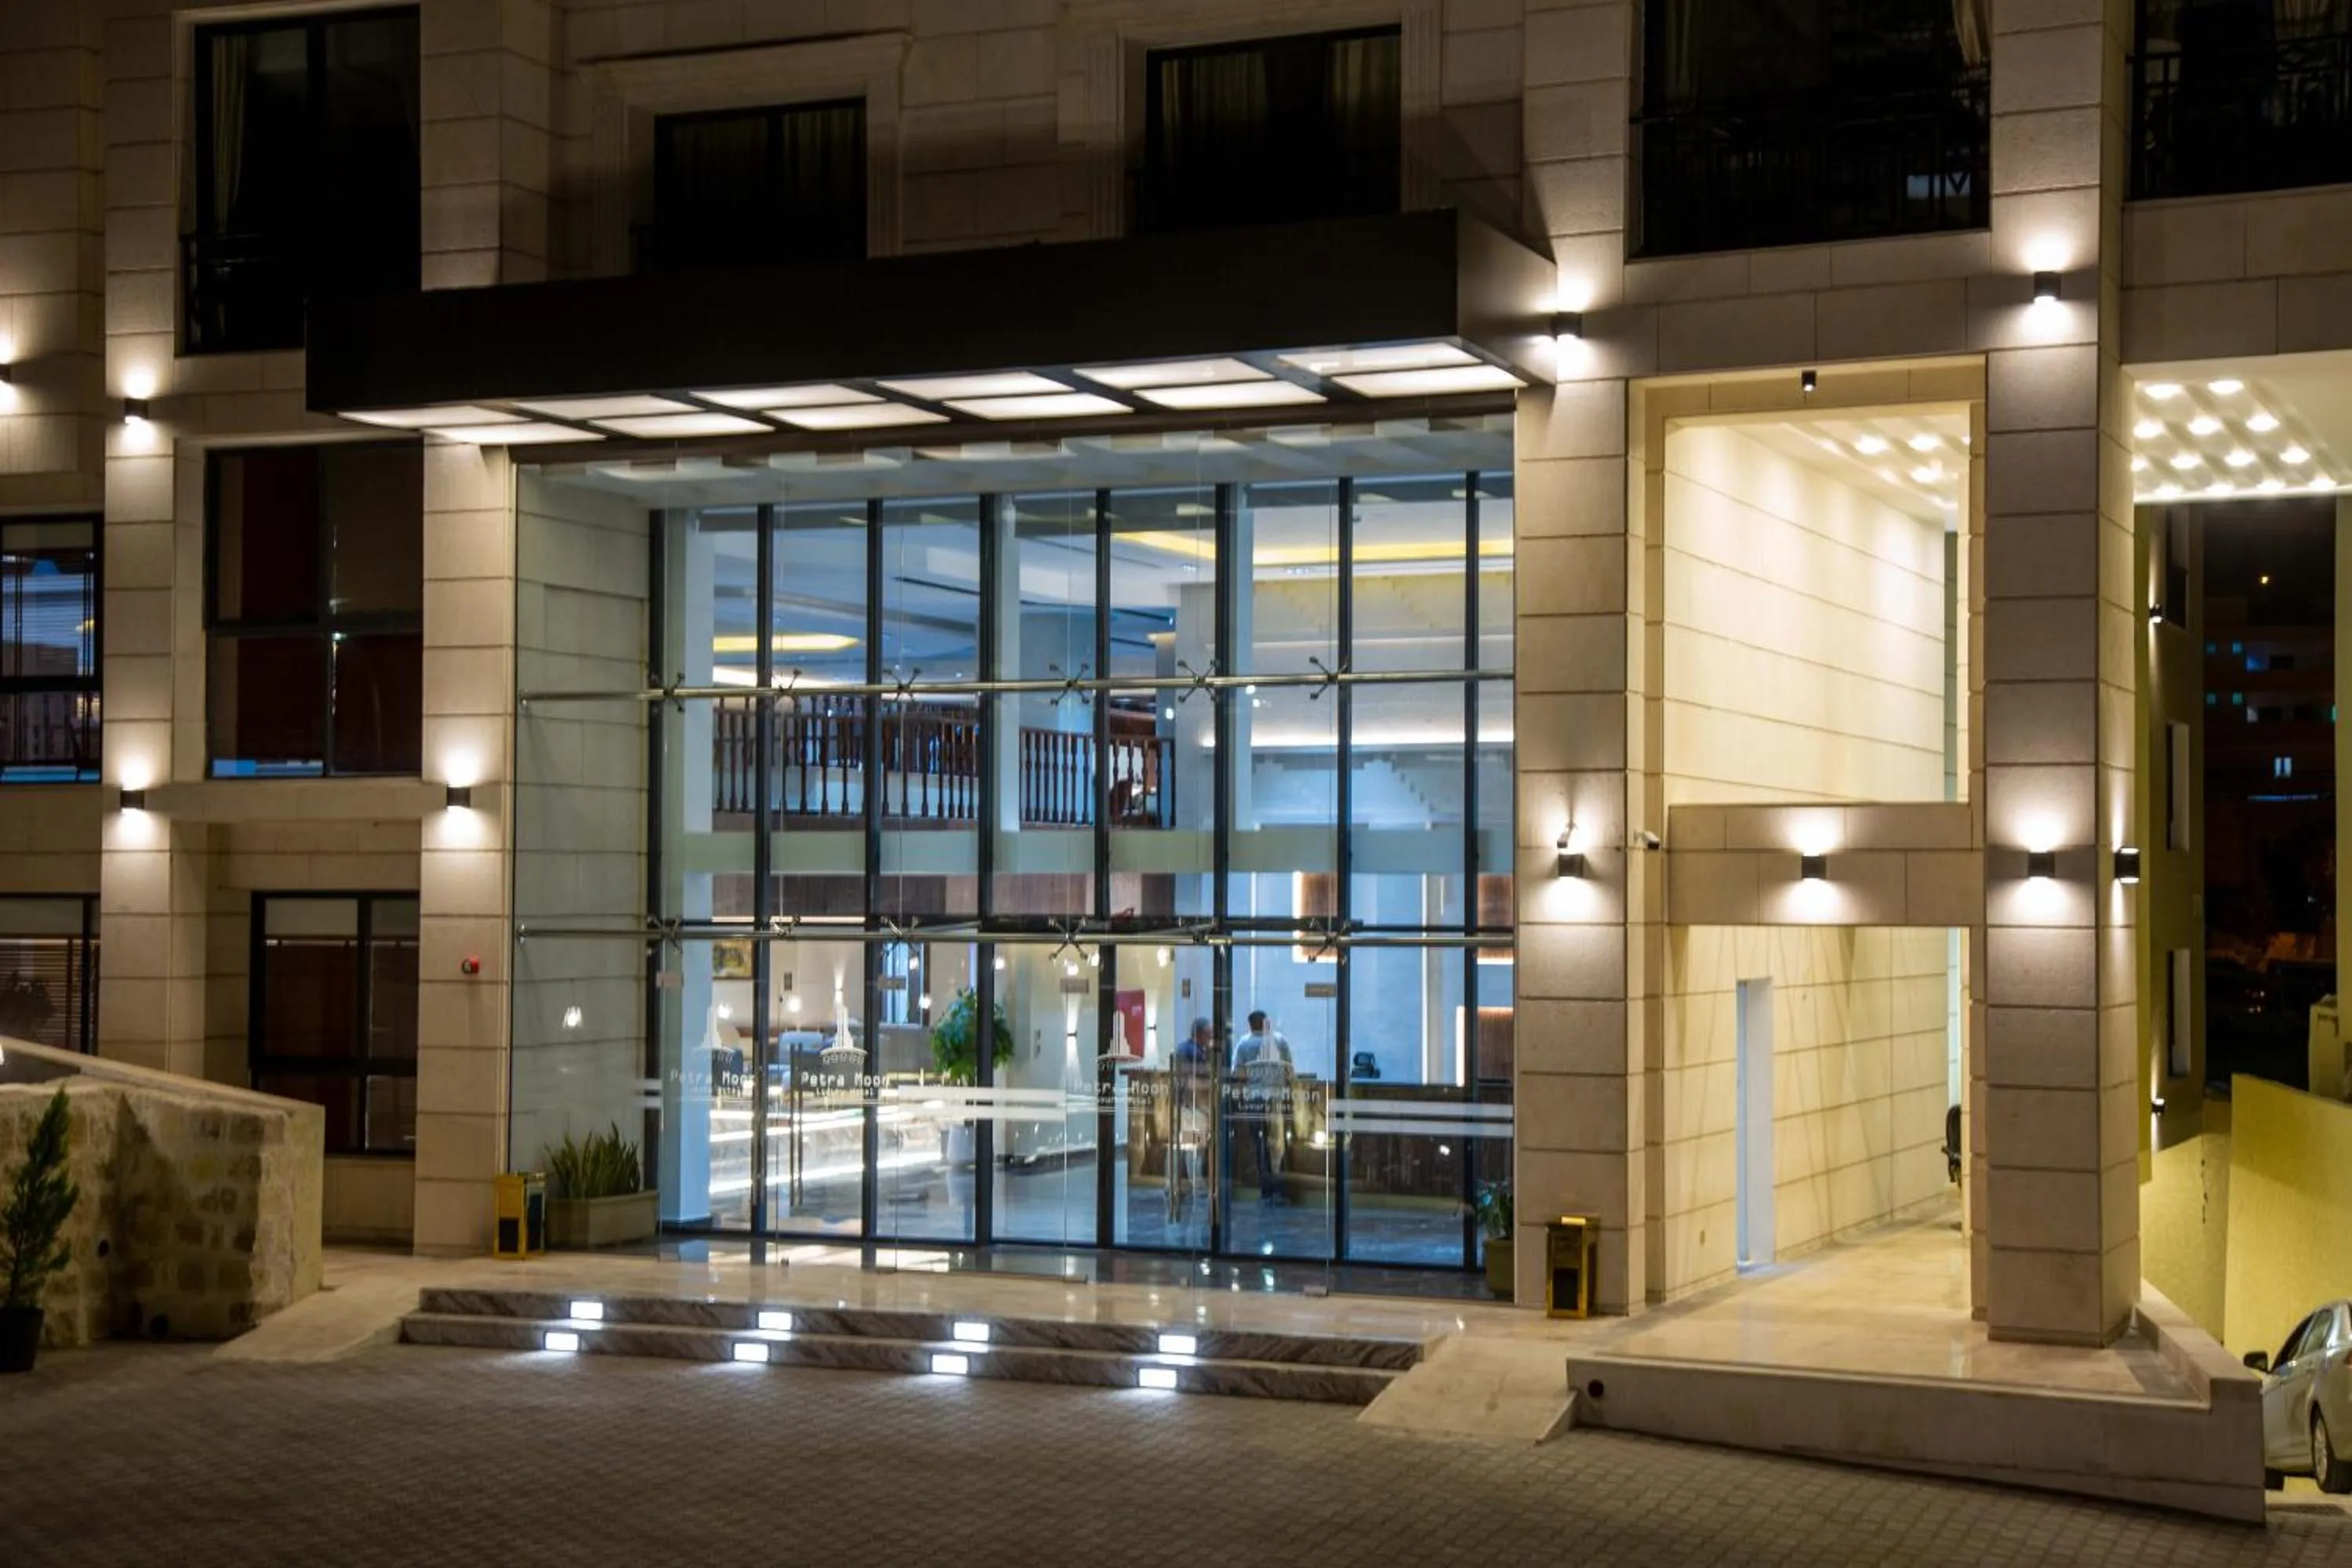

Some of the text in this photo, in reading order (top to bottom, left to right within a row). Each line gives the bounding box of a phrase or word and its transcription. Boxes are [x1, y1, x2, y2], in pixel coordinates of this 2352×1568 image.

[800, 1071, 890, 1088] Petra Moon
[1131, 1080, 1169, 1096] Moon
